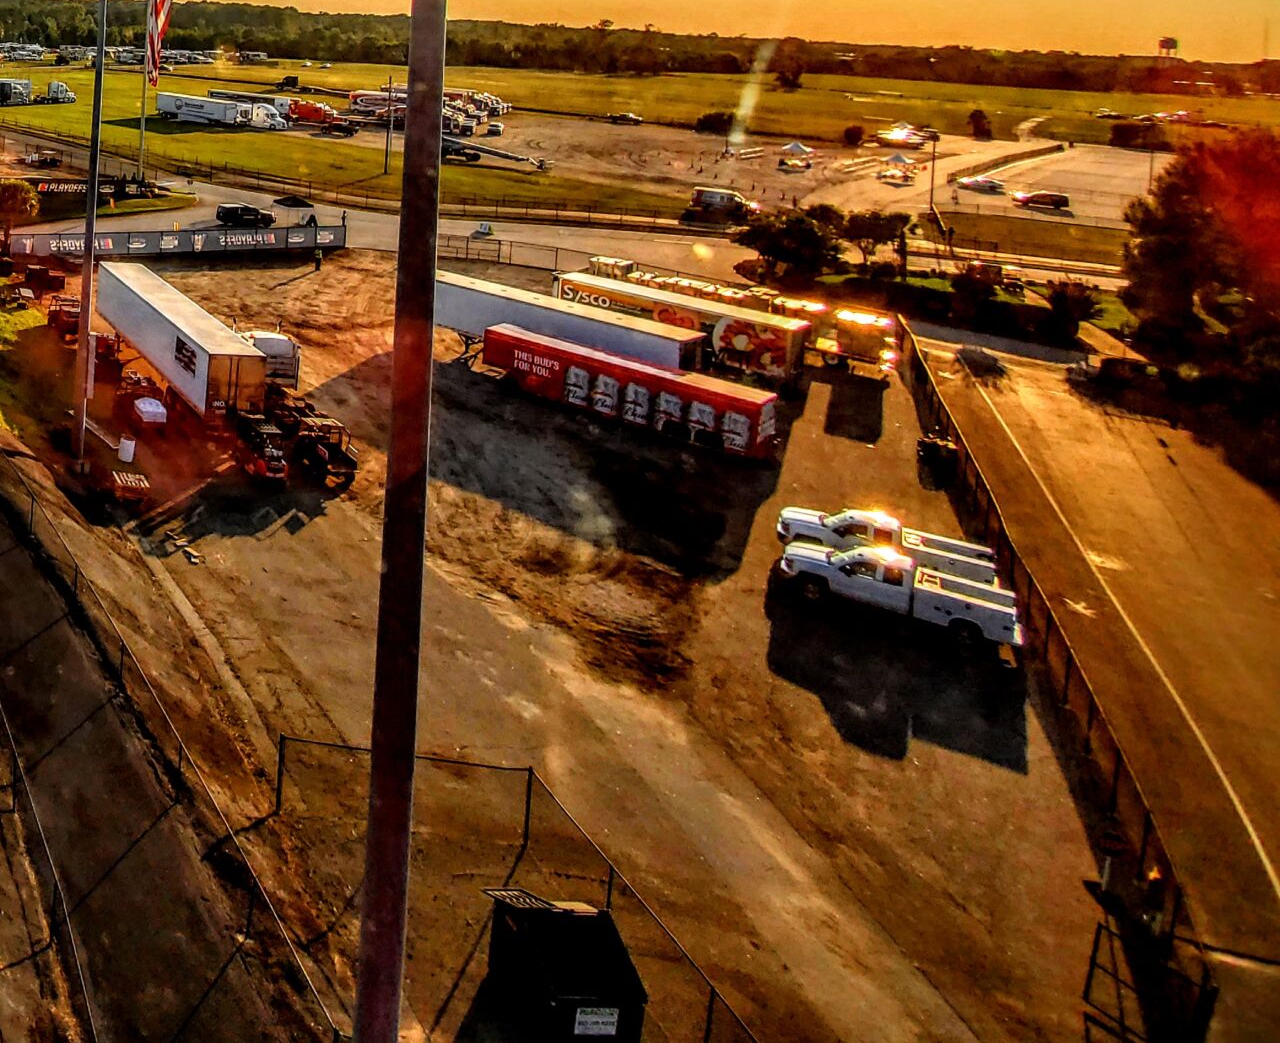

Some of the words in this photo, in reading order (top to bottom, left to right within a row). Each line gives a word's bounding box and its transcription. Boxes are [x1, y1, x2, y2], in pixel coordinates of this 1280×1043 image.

[48, 183, 88, 193] PLAYOFFS
[514, 349, 533, 363] THIS
[534, 355, 560, 371] BUD'S
[514, 359, 531, 372] FOR
[532, 364, 551, 378] YOU.
